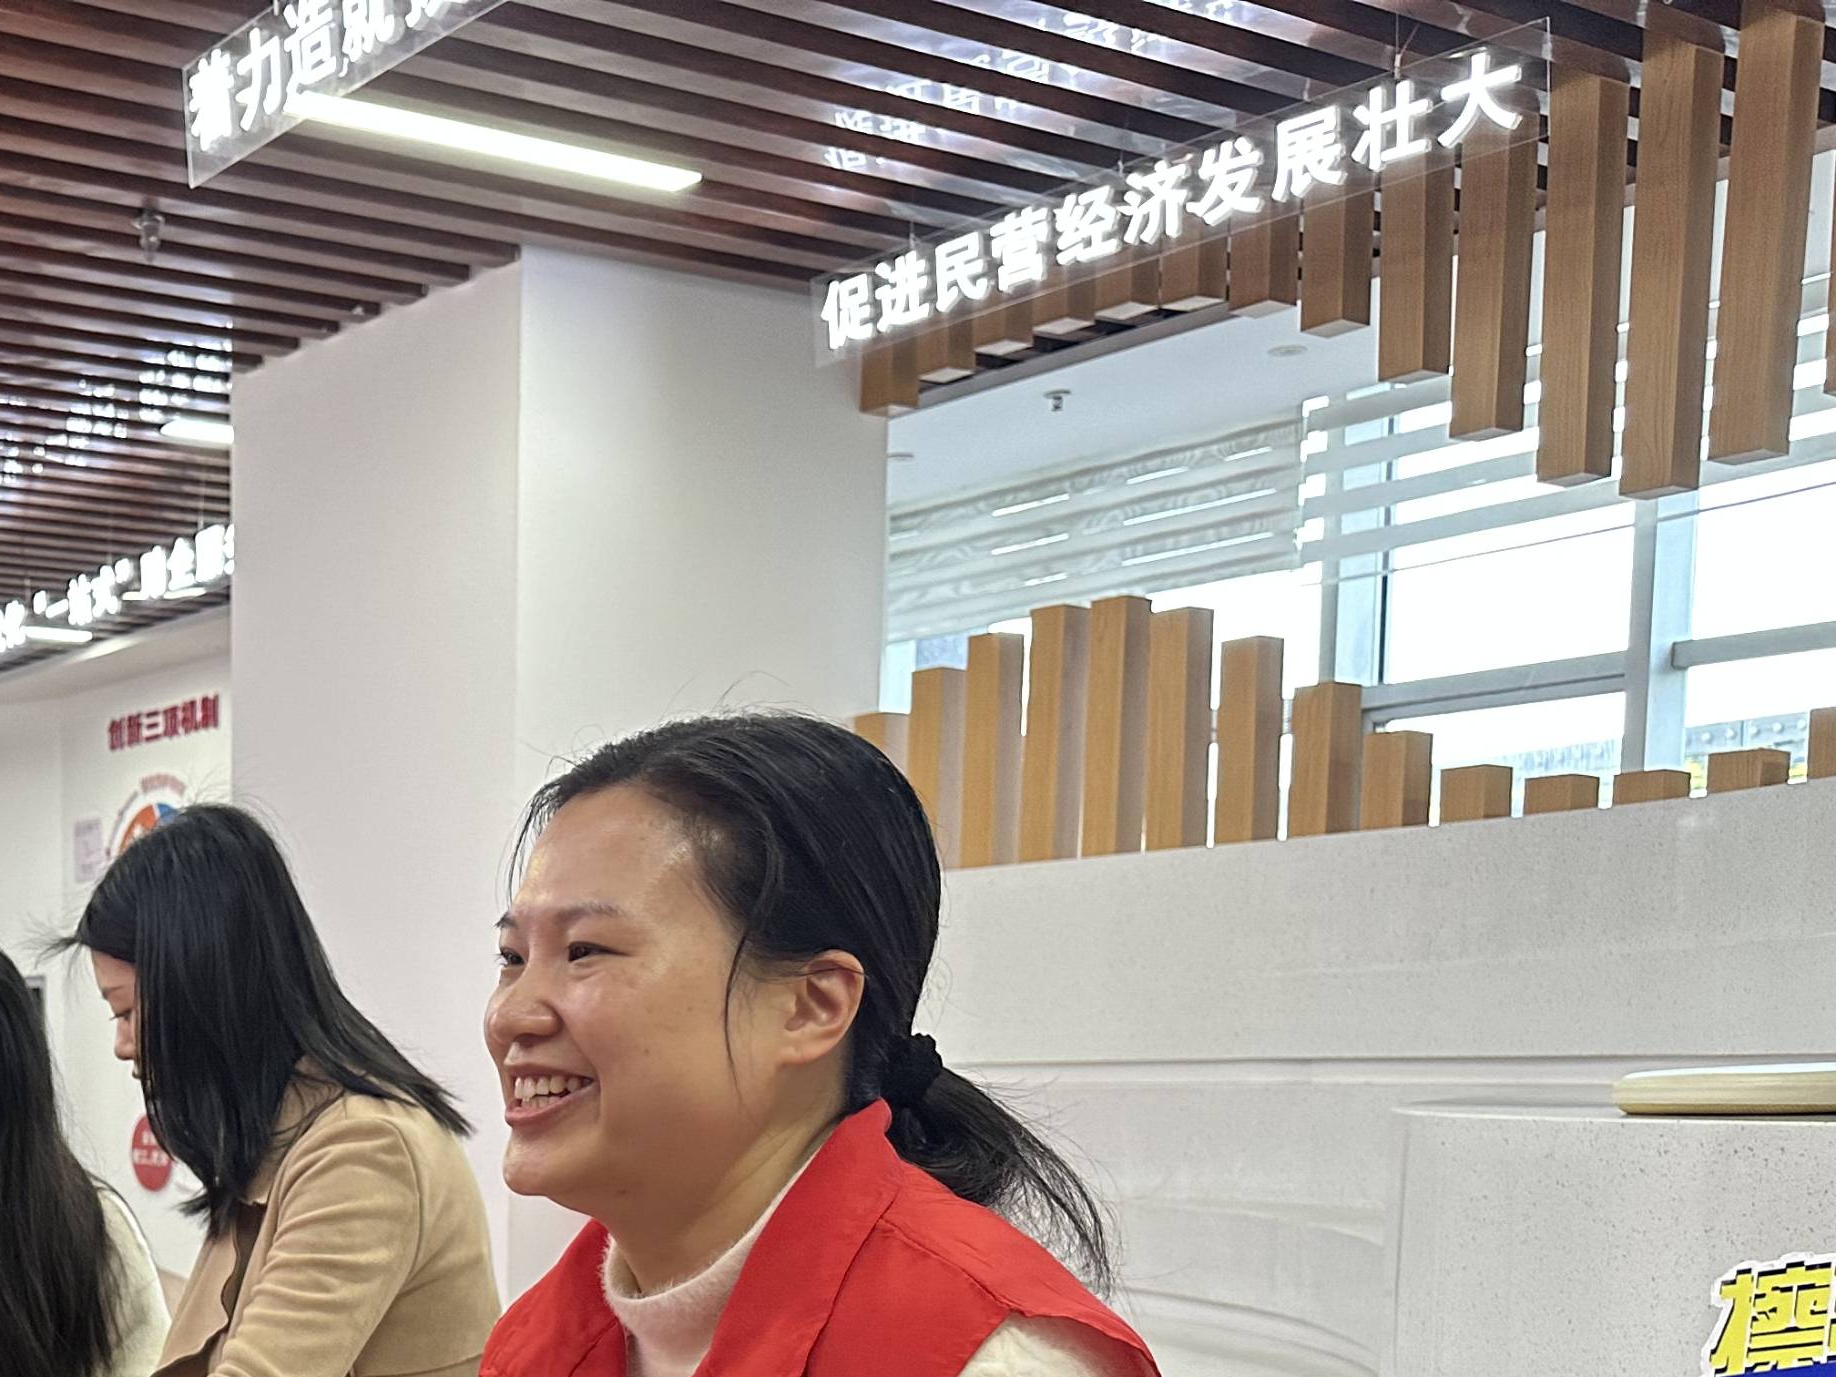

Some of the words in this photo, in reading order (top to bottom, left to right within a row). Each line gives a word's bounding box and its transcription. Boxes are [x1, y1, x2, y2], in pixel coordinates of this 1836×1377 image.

[820, 50, 1522, 350] 促进民营经济发展壮大
[108, 693, 220, 752] 创新三项机制
